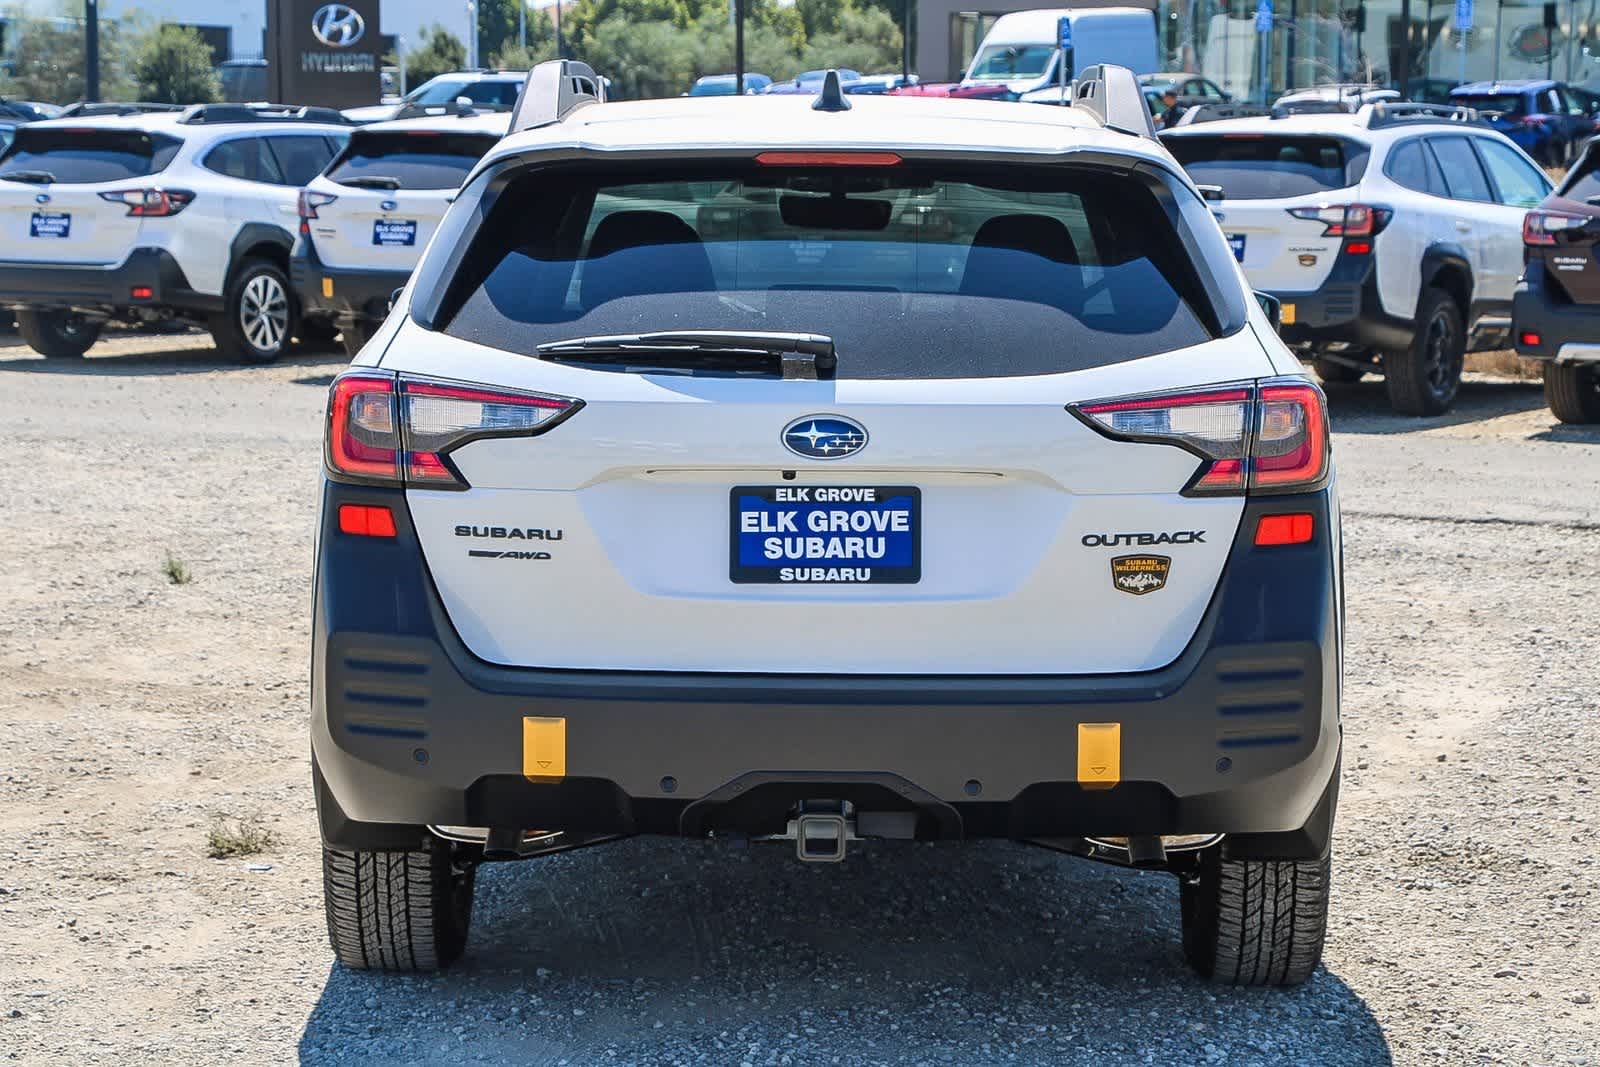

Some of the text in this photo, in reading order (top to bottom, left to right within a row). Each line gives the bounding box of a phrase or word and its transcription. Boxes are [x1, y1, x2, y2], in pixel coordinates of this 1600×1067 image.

[775, 488, 876, 502] ELK GROVE
[740, 510, 910, 533] ELK GROVE
[454, 525, 563, 541] SUBARU
[1081, 530, 1207, 547] OUTBACK
[763, 536, 886, 560] SUBARU
[499, 551, 552, 560] AWD
[1125, 558, 1158, 566] SUBARU
[779, 568, 871, 582] SUBARU
[1115, 564, 1167, 572] WILDERNESS
